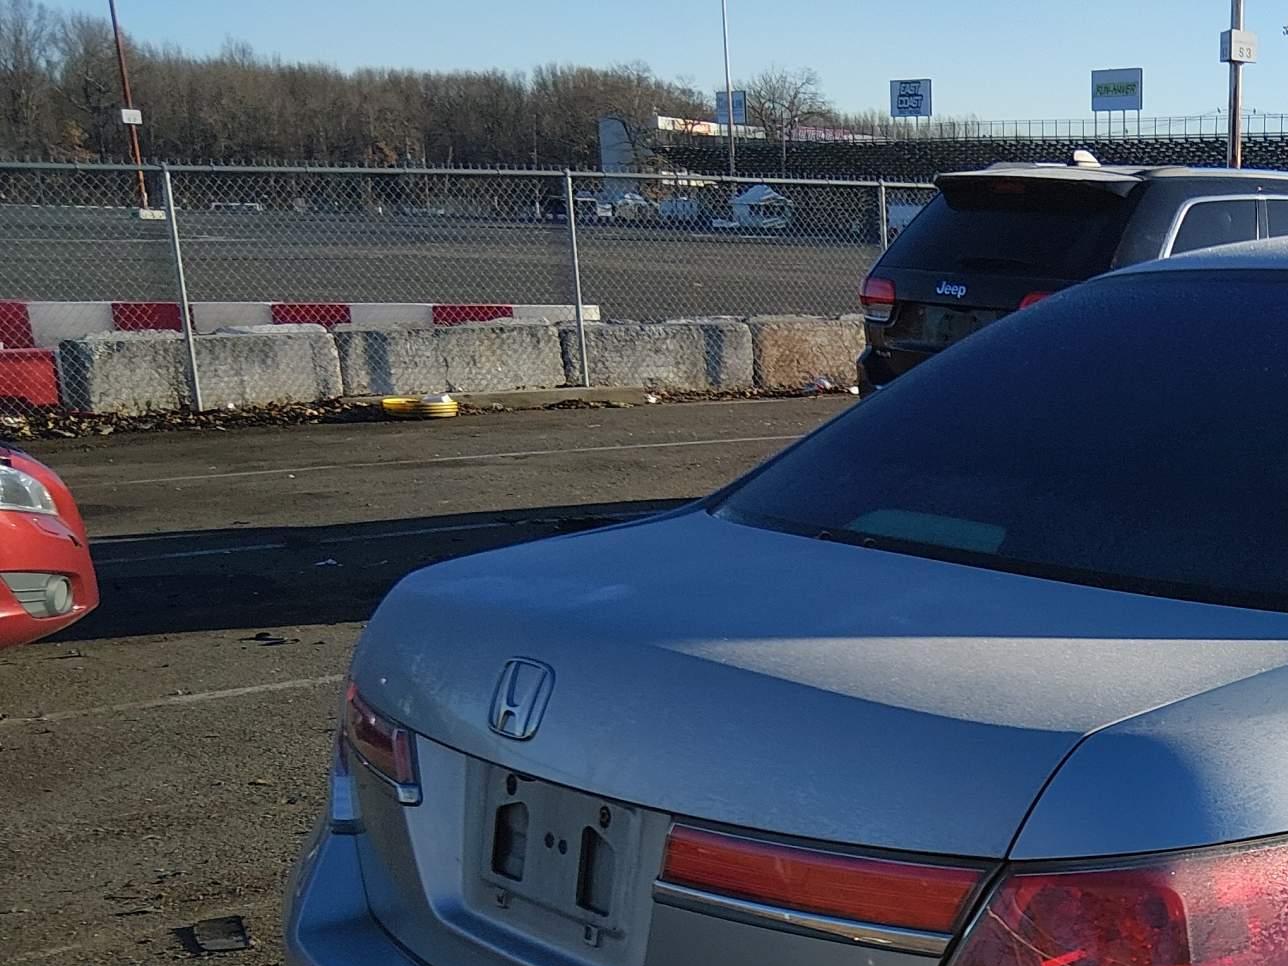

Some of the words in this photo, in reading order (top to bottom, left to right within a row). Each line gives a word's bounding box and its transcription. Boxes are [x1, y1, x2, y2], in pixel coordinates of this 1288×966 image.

[900, 82, 921, 95] EAST
[897, 95, 923, 109] COAST
[936, 281, 967, 298] Jeep
